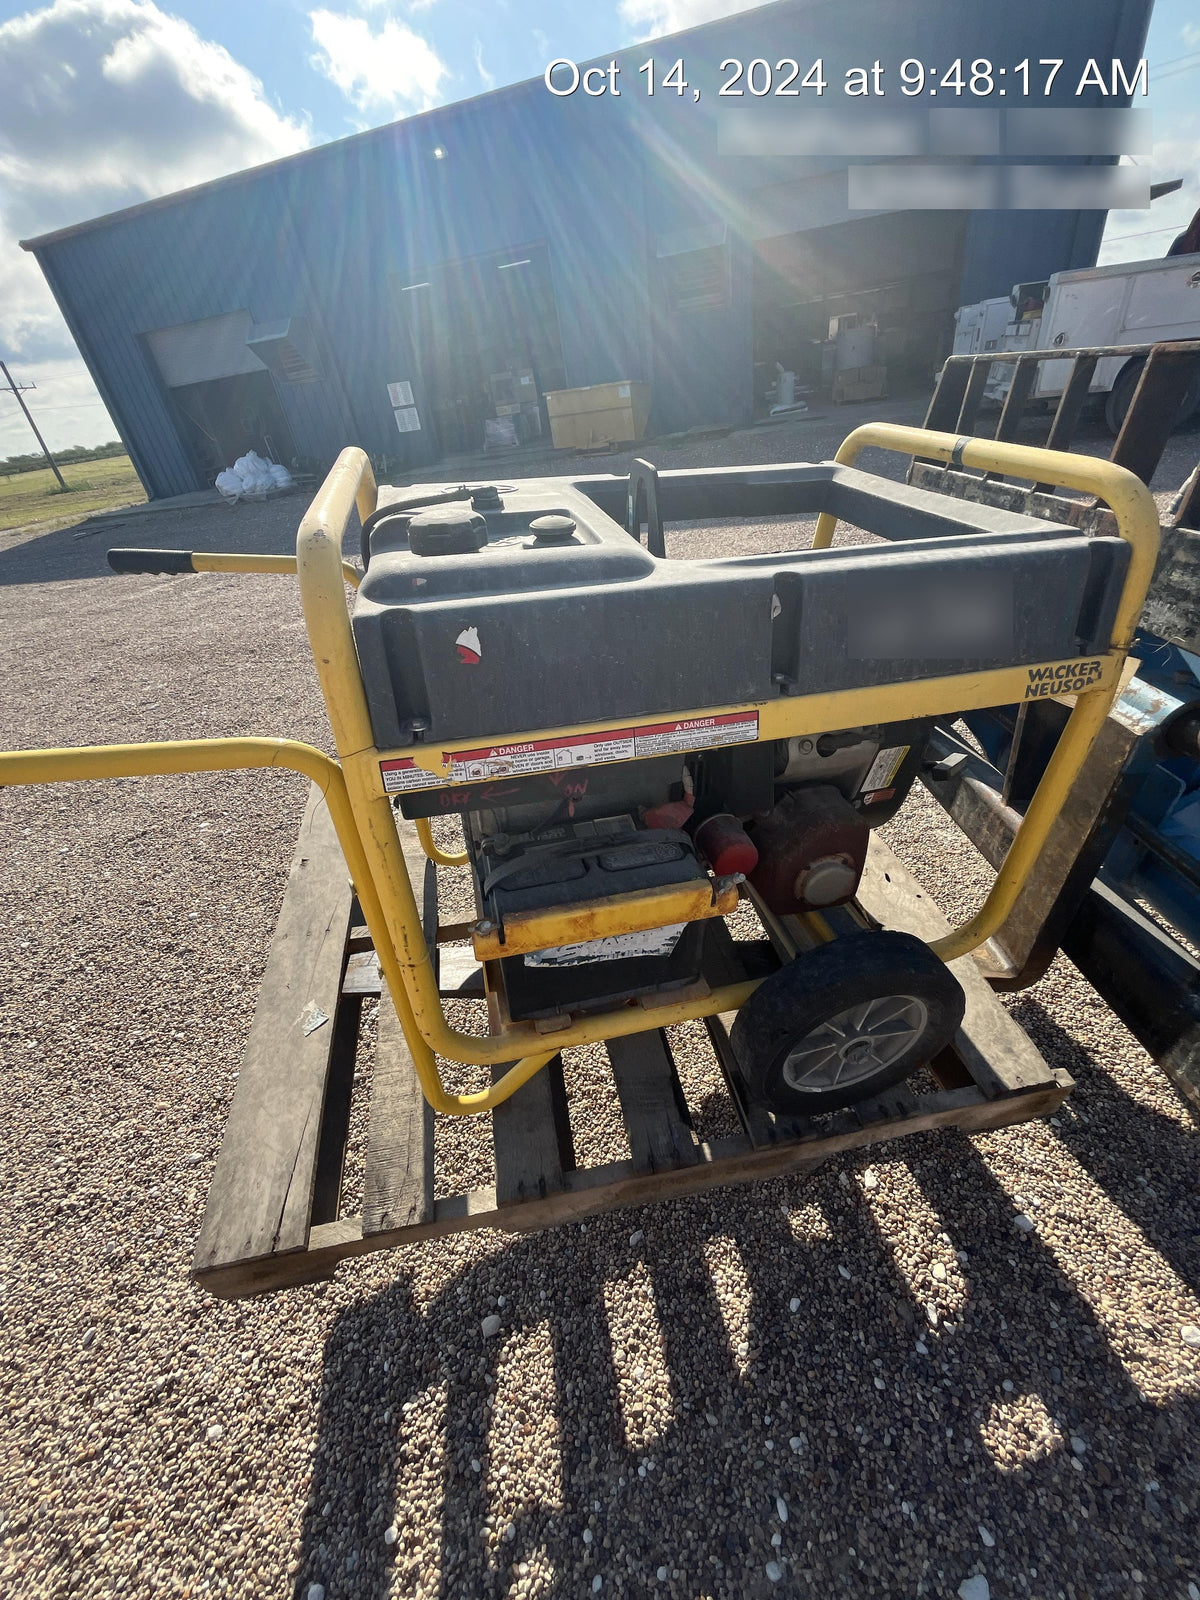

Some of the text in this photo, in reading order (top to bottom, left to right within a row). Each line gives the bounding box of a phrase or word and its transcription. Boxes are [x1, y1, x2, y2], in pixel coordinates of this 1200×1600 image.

[1028, 661, 1101, 682] WACKER
[684, 718, 716, 730] DANGER
[499, 744, 534, 755] DANGER
